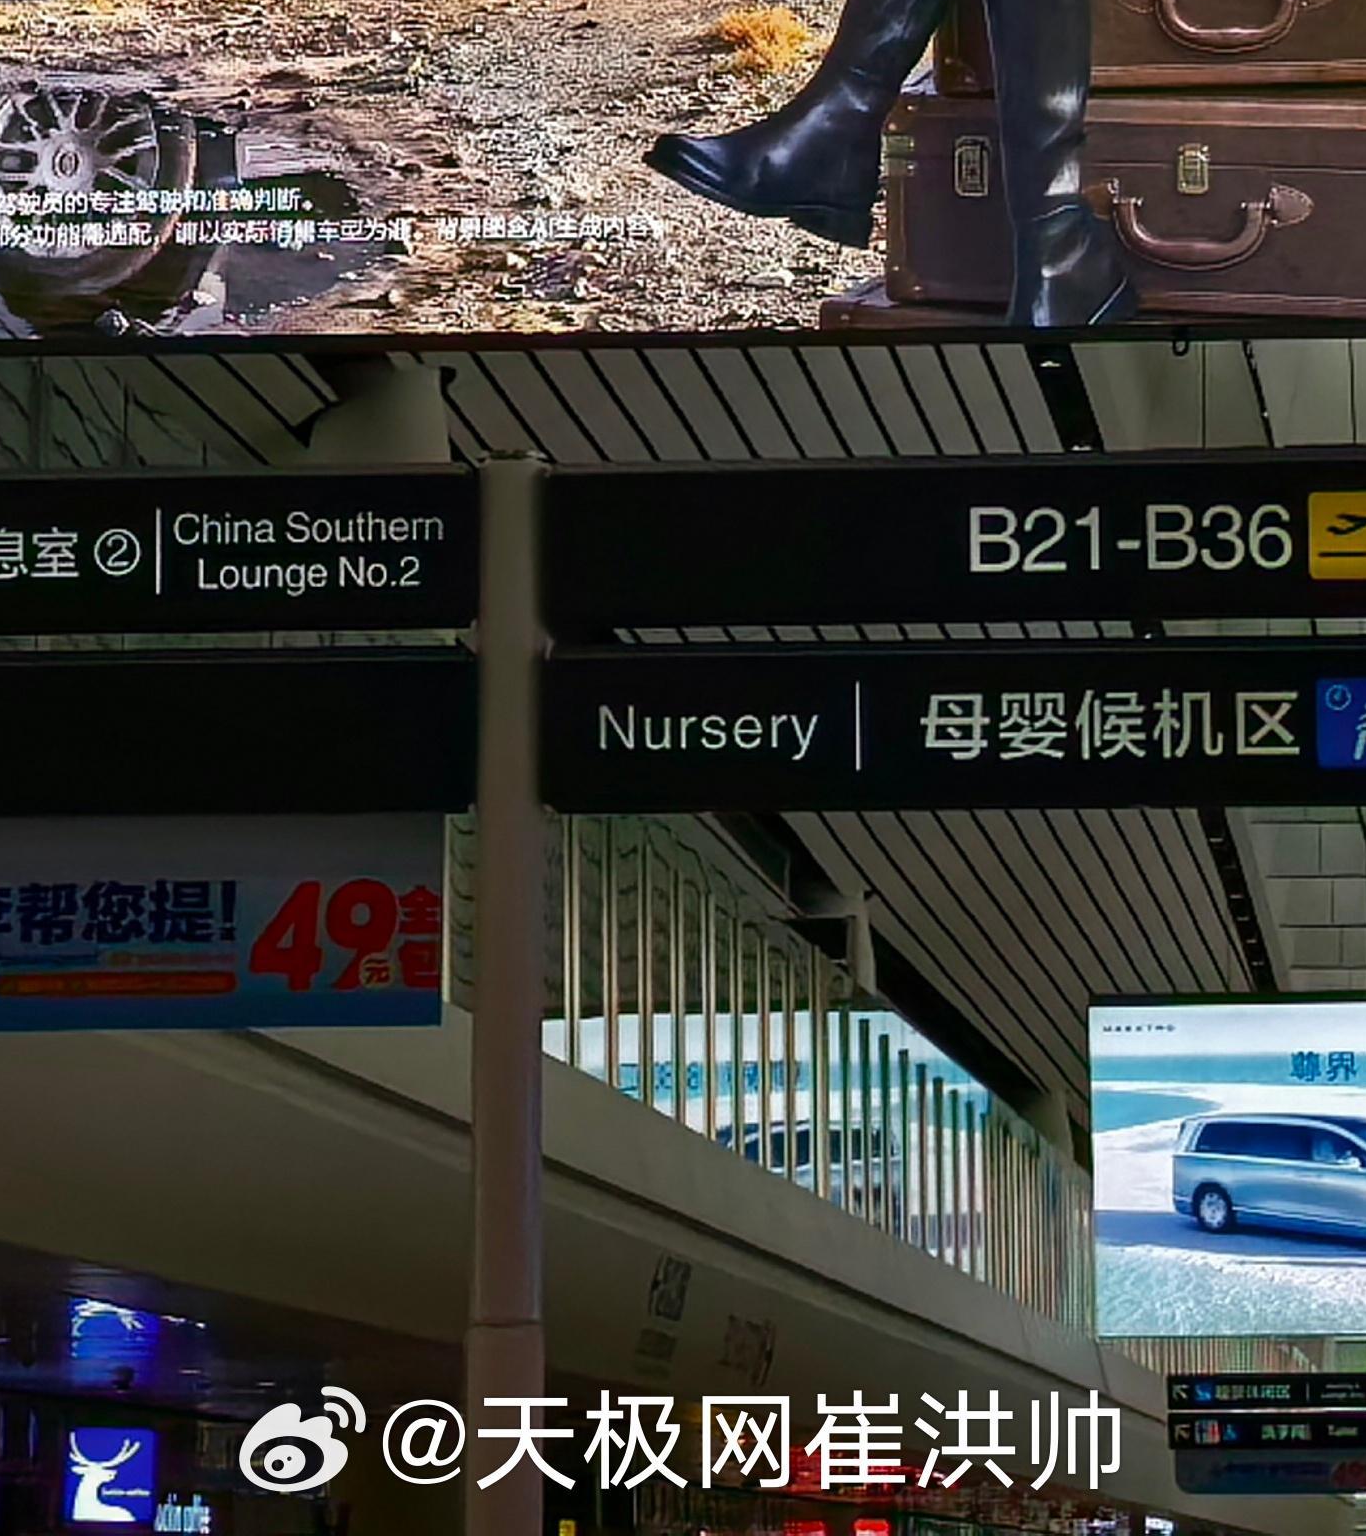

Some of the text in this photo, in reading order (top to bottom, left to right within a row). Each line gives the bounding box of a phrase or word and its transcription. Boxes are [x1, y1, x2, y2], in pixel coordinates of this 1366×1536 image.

[173, 511, 445, 545] China Southern
[968, 504, 1294, 573] B21-B36
[197, 556, 421, 597] Lounge No.2
[597, 703, 819, 761] Nursery
[920, 688, 1301, 760] 母婴候机区
[248, 877, 399, 993] 49
